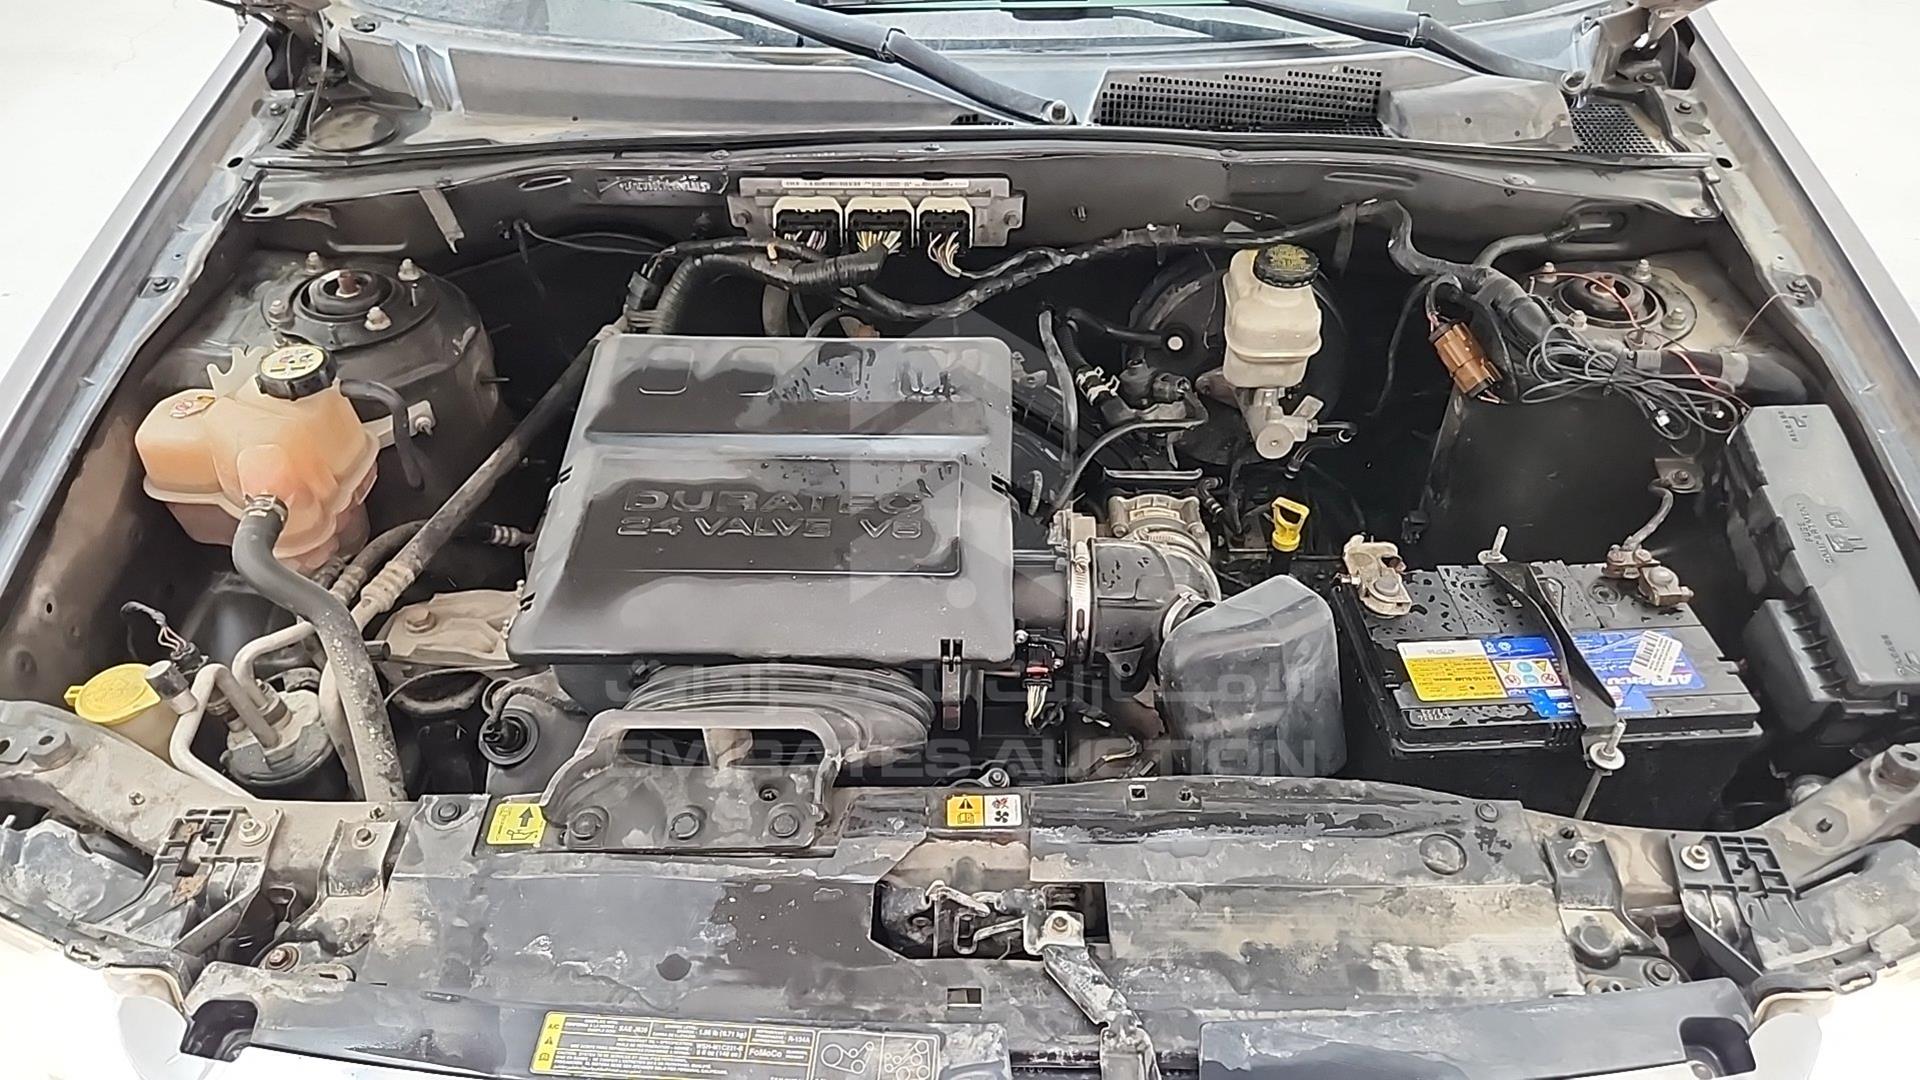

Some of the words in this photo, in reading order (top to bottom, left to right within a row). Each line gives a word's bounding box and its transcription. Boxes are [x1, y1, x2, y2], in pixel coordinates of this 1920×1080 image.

[623, 490, 926, 514] DURATEC
[617, 516, 684, 537] 24
[694, 517, 832, 538] VALVE
[859, 518, 922, 540] V6
[749, 1048, 783, 1058] FoMoCo
